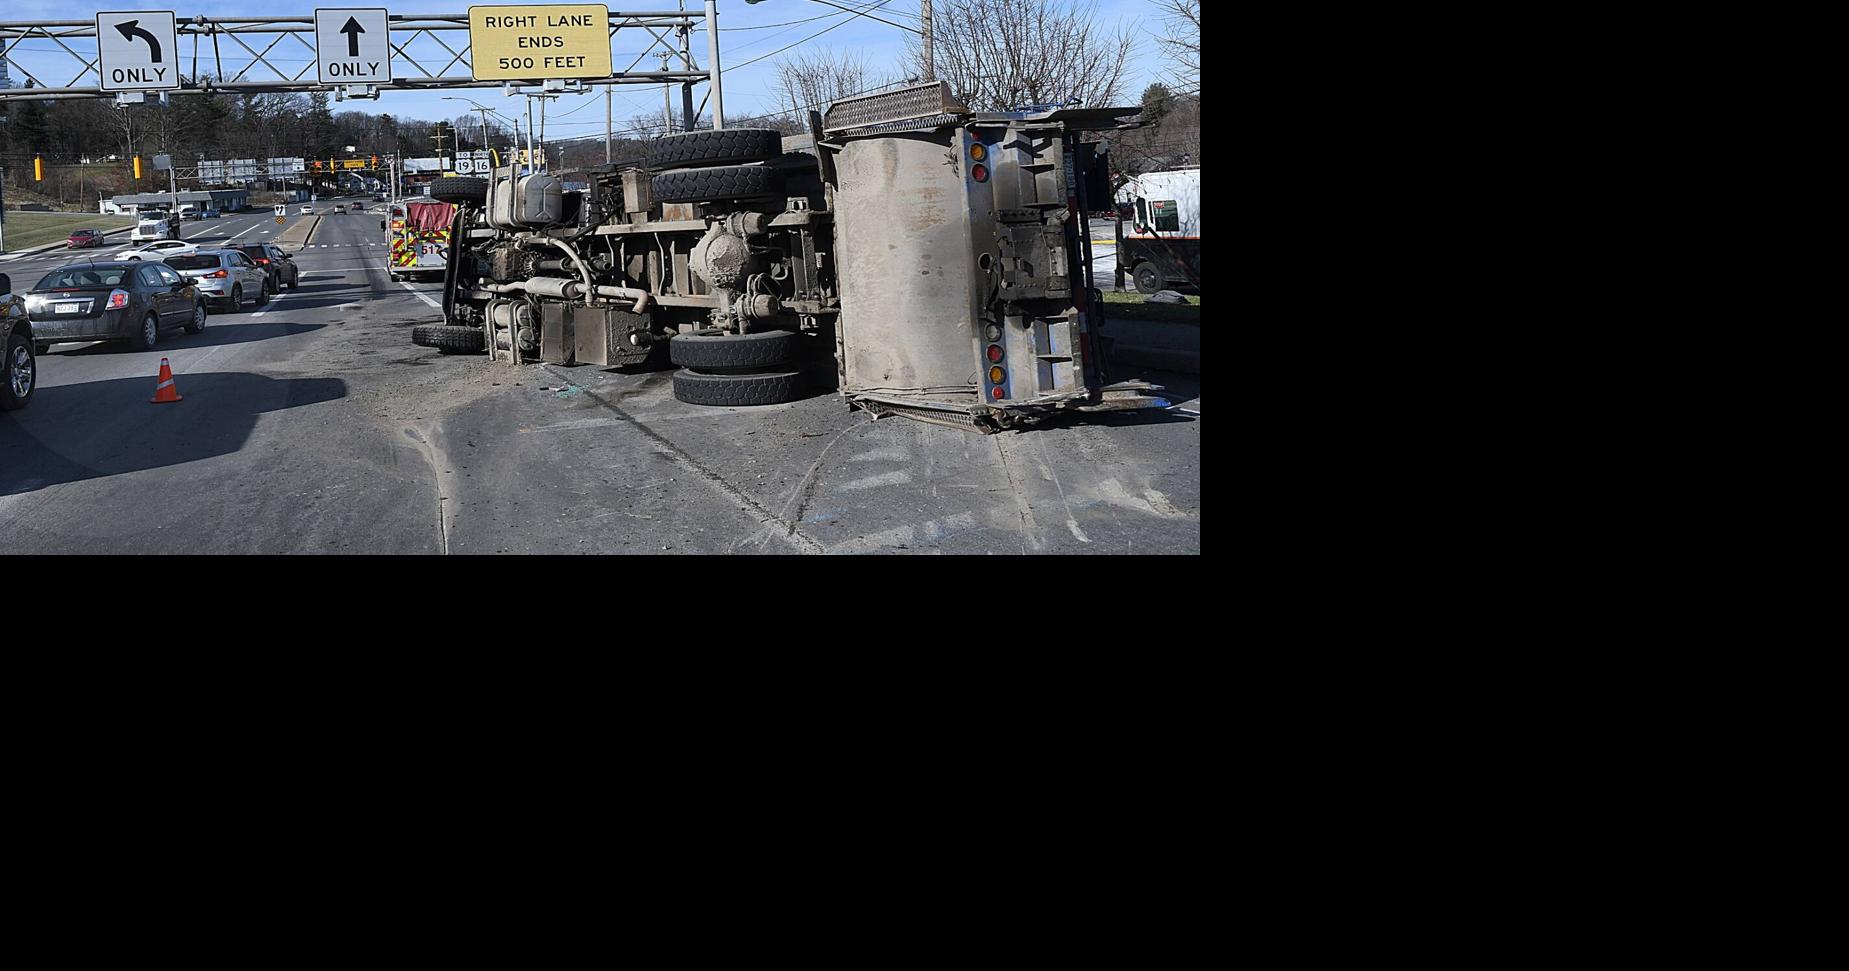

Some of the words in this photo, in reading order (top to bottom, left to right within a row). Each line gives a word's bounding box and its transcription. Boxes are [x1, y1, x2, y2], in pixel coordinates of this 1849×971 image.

[485, 15, 537, 28] RIGHT
[547, 14, 594, 27] LANE
[518, 36, 564, 49] ENDS
[329, 61, 380, 77] ONLY
[499, 57, 534, 70] 500
[544, 56, 586, 69] FEET
[112, 67, 167, 83] ONLY
[459, 162, 469, 171] 19
[477, 162, 488, 170] 16
[422, 245, 441, 255] 517
